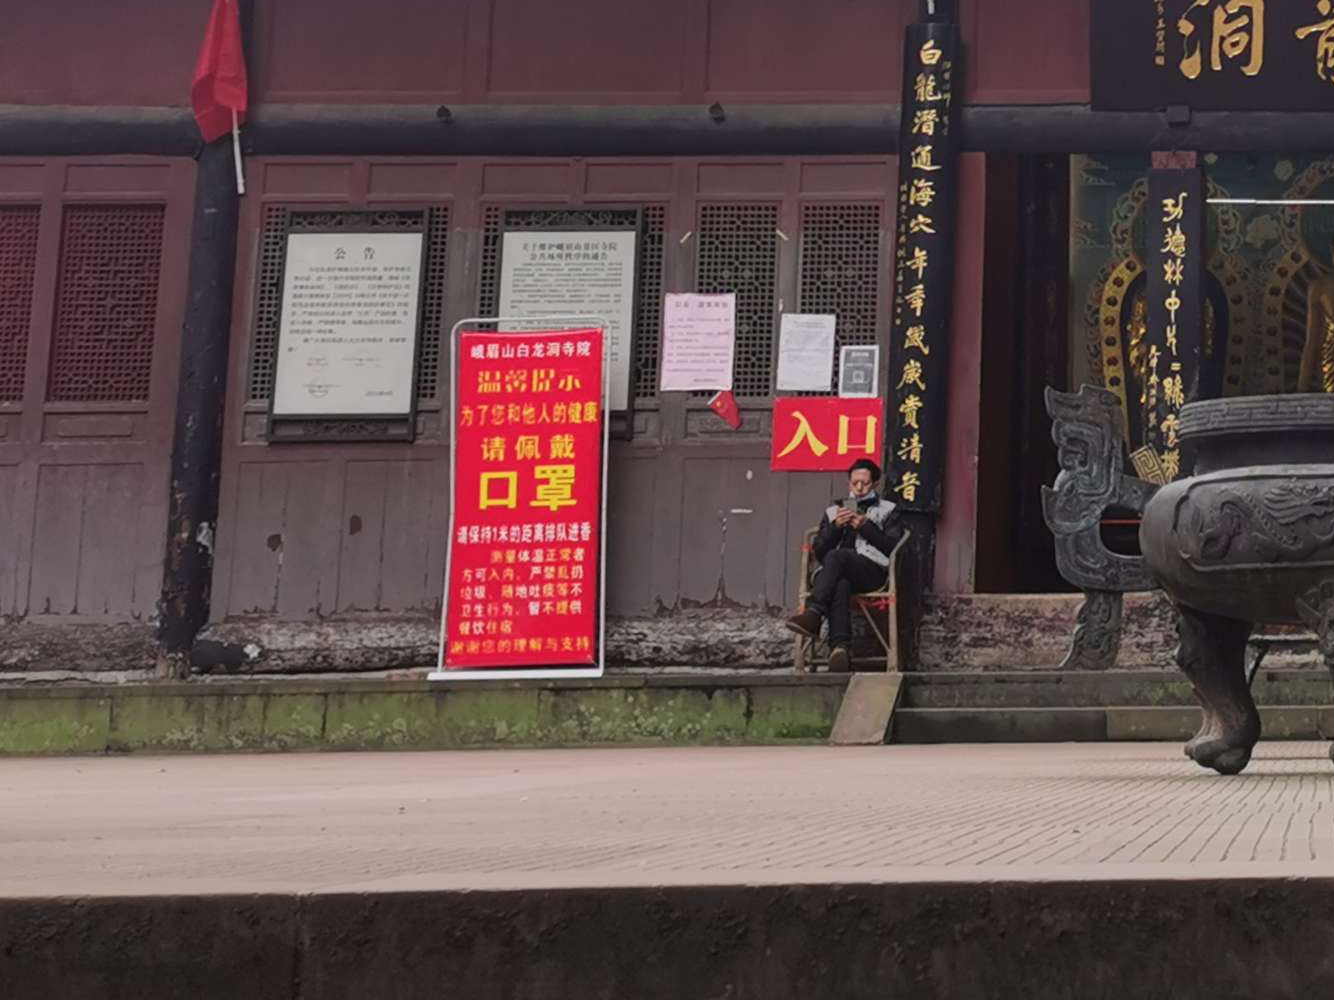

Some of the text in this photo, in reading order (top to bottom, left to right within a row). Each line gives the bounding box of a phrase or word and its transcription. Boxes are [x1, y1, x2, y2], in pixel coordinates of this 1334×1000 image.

[469, 341, 592, 360] 峨眉山白龙洞寺院
[477, 367, 582, 394] 温馨提示
[460, 401, 599, 427] 为了您和他人的健康
[776, 410, 878, 459] 入口
[480, 434, 577, 462] 请佩戴
[478, 463, 578, 512] 口罩
[456, 521, 592, 545] 请保持1米的距离排队进香
[490, 547, 586, 564] 测量体温正常者
[459, 620, 513, 636] 餐饮住宿
[450, 636, 590, 655] 谢谢您的理解与支持
